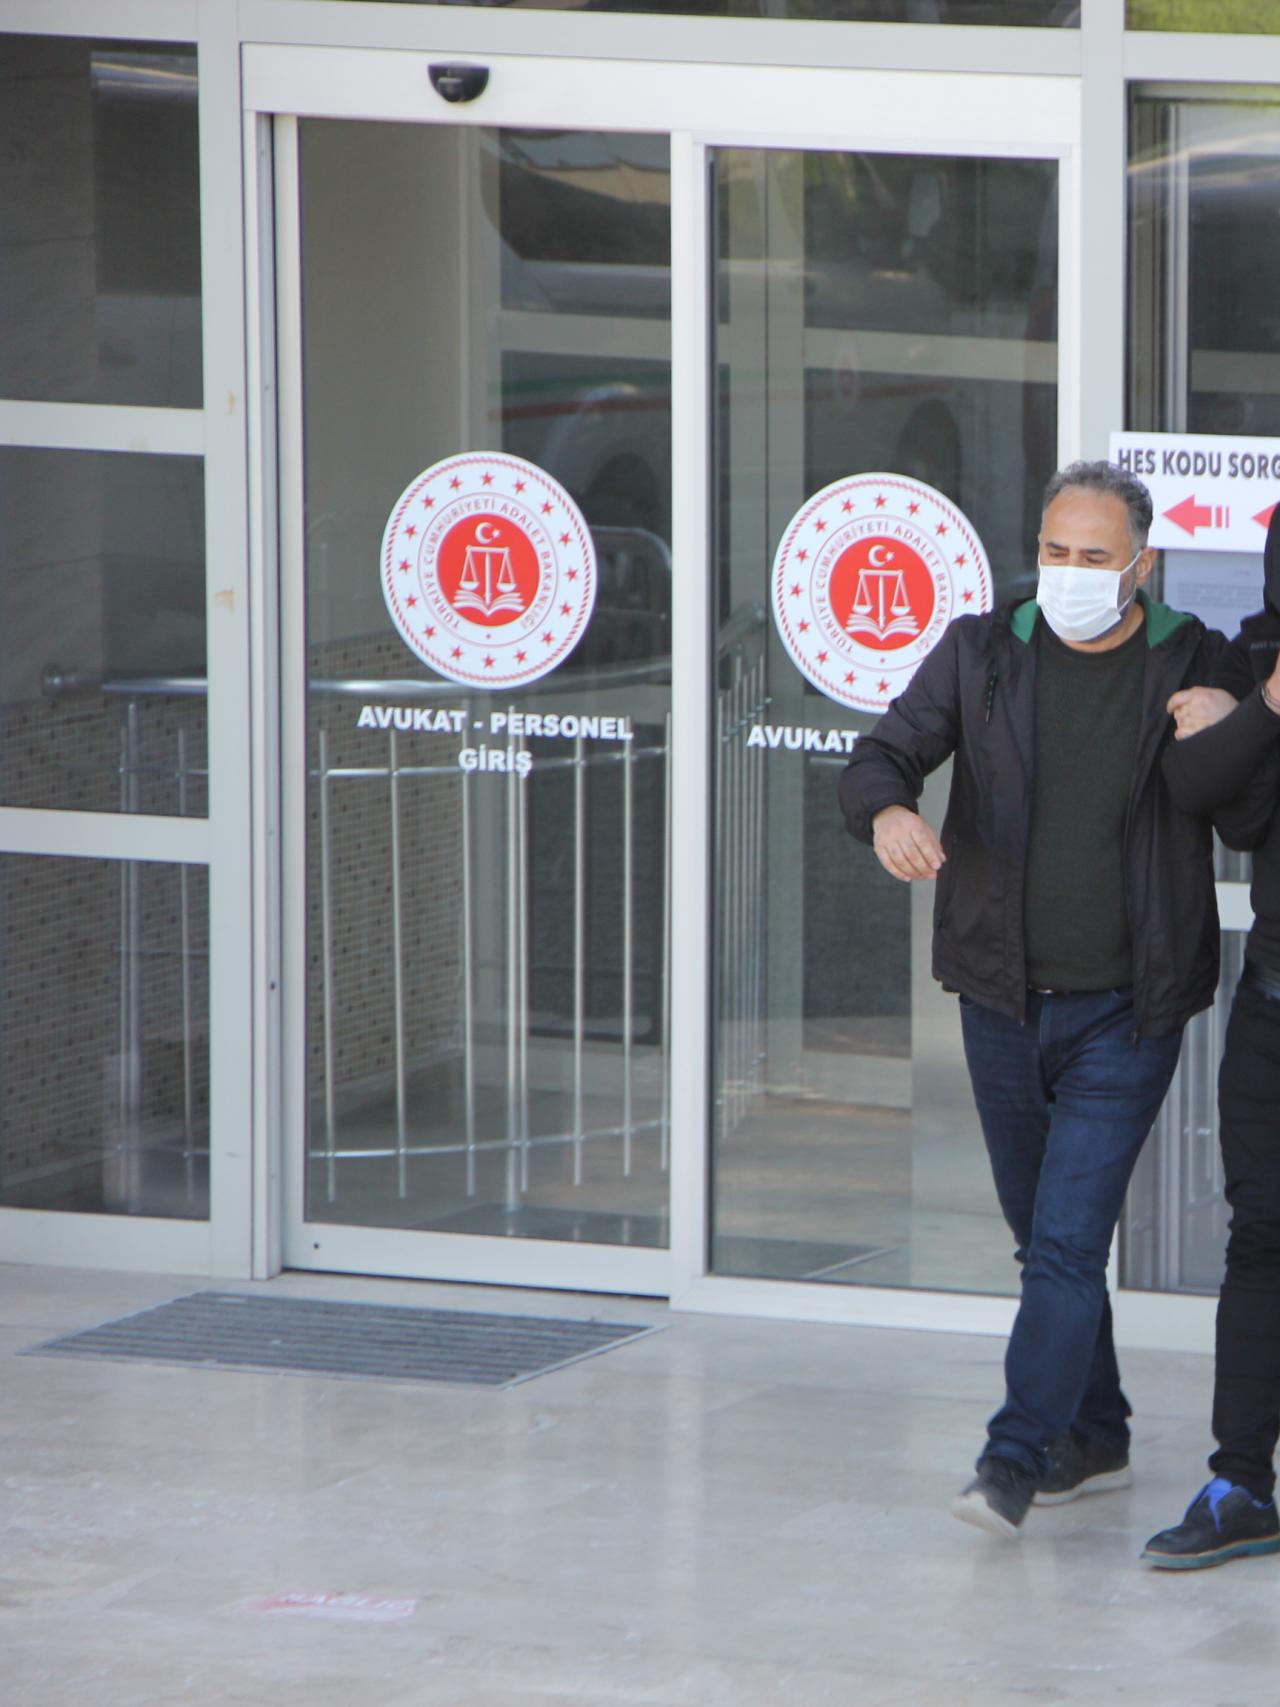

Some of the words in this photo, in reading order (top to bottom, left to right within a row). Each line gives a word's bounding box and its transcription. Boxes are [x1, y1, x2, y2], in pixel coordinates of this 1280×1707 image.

[1118, 449, 1156, 475] HES
[1162, 450, 1222, 478] KODU
[500, 502, 546, 545] ADALET
[357, 705, 467, 733] AVUKAT
[490, 712, 633, 740] PERSONEL
[746, 724, 859, 753] AVUKAT
[458, 744, 533, 779] GİRİŞ
